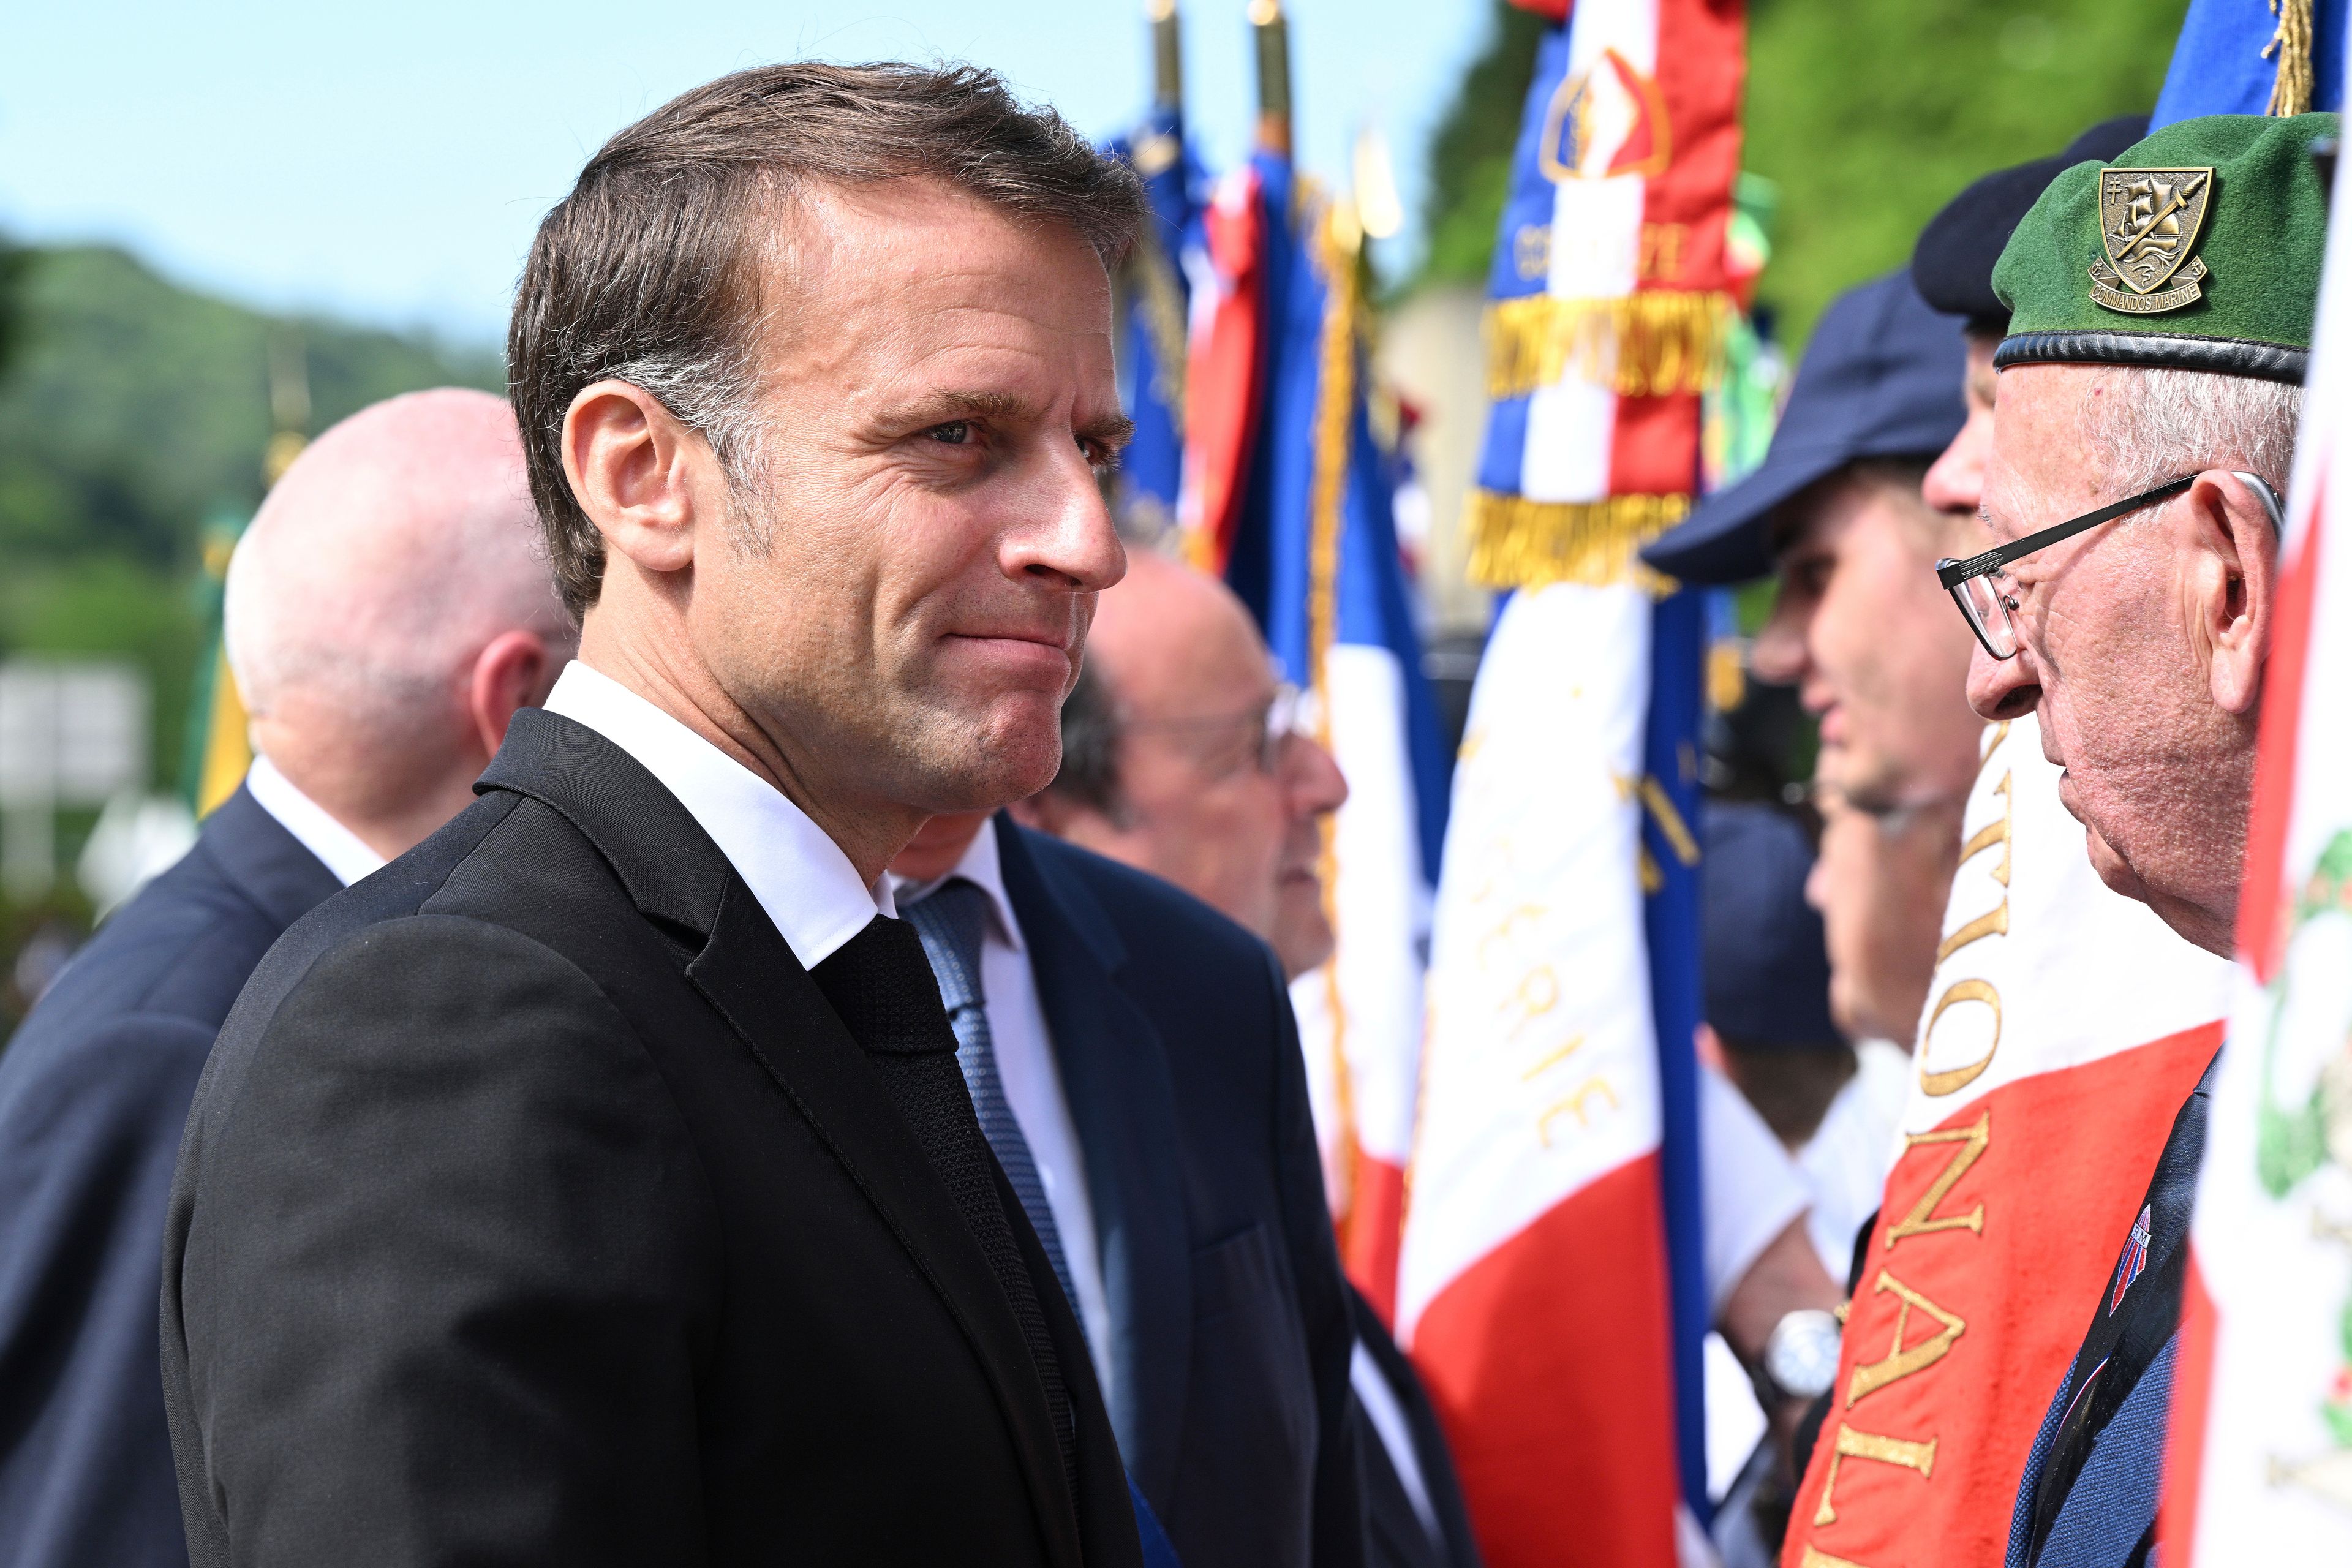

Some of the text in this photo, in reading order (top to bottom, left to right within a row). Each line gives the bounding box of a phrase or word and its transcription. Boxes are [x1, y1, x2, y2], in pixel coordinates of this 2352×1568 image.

[2091, 284, 2199, 311] COMMANDOS MARINE
[1800, 720, 2011, 1568] TIONAL
